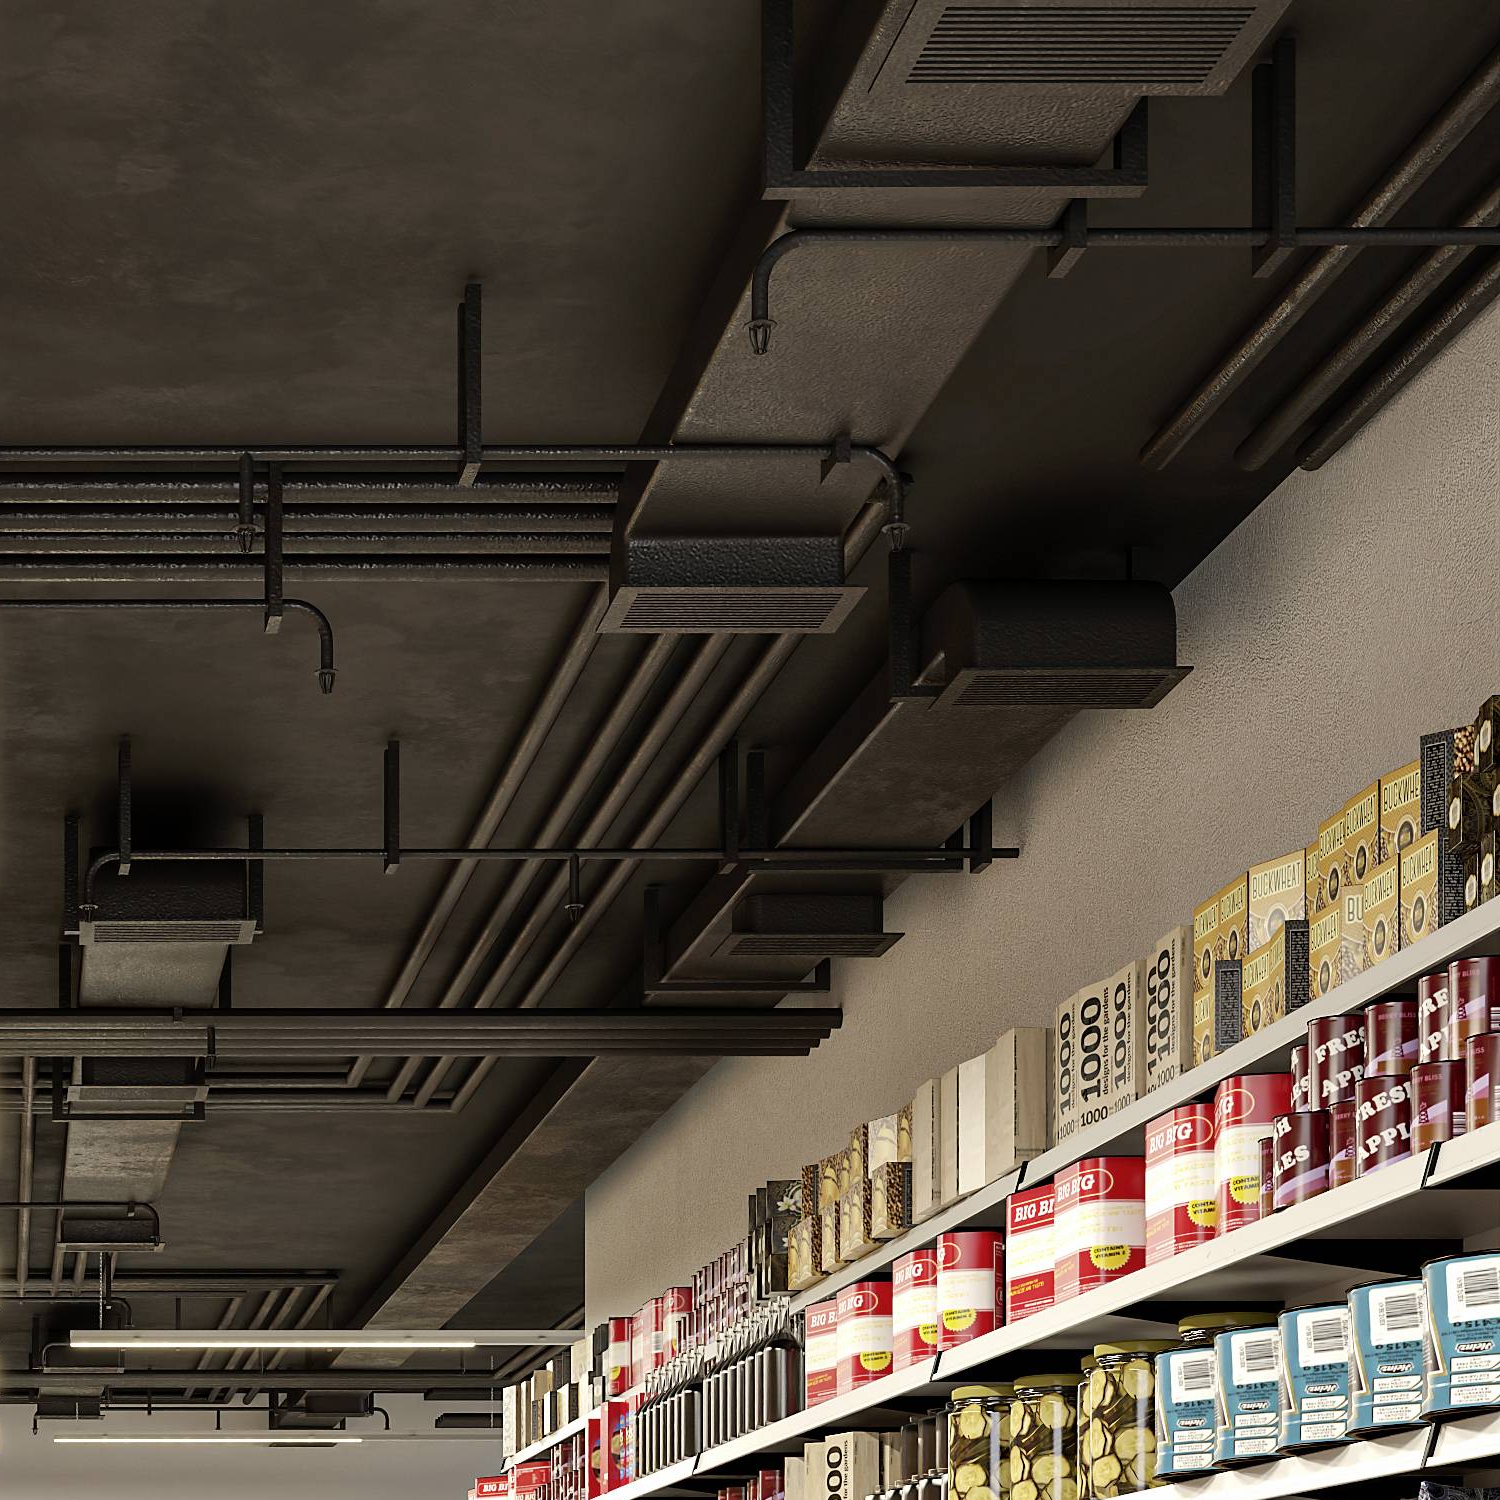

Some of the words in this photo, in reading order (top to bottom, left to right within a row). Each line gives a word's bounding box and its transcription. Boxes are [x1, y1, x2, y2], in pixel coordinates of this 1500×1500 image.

[1383, 771, 1420, 814] BUCKWHE
[1252, 861, 1301, 899] BUCKWHEAT
[1102, 987, 1110, 1025] gardens
[1157, 949, 1171, 1062] 1000
[1080, 997, 1101, 1103] 1000
[1114, 981, 1127, 1091] 1000
[1314, 1025, 1366, 1065] FRES
[1059, 1012, 1071, 1116] 1000
[1102, 1059, 1110, 1095] designs
[1321, 1064, 1365, 1098] APP
[1059, 1119, 1076, 1140] 1000
[1080, 1105, 1108, 1127] 1000
[1149, 1134, 1164, 1154] BIG
[1165, 1123, 1193, 1145] BIG
[1357, 1122, 1411, 1165] APPL
[1057, 1185, 1070, 1201] BIG
[1071, 1174, 1095, 1196] BIG
[1014, 1202, 1037, 1223] BIG
[1038, 1198, 1055, 1217] BI
[905, 1263, 923, 1280] BIG
[810, 1314, 827, 1328] BIG
[497, 1483, 508, 1491] BI
